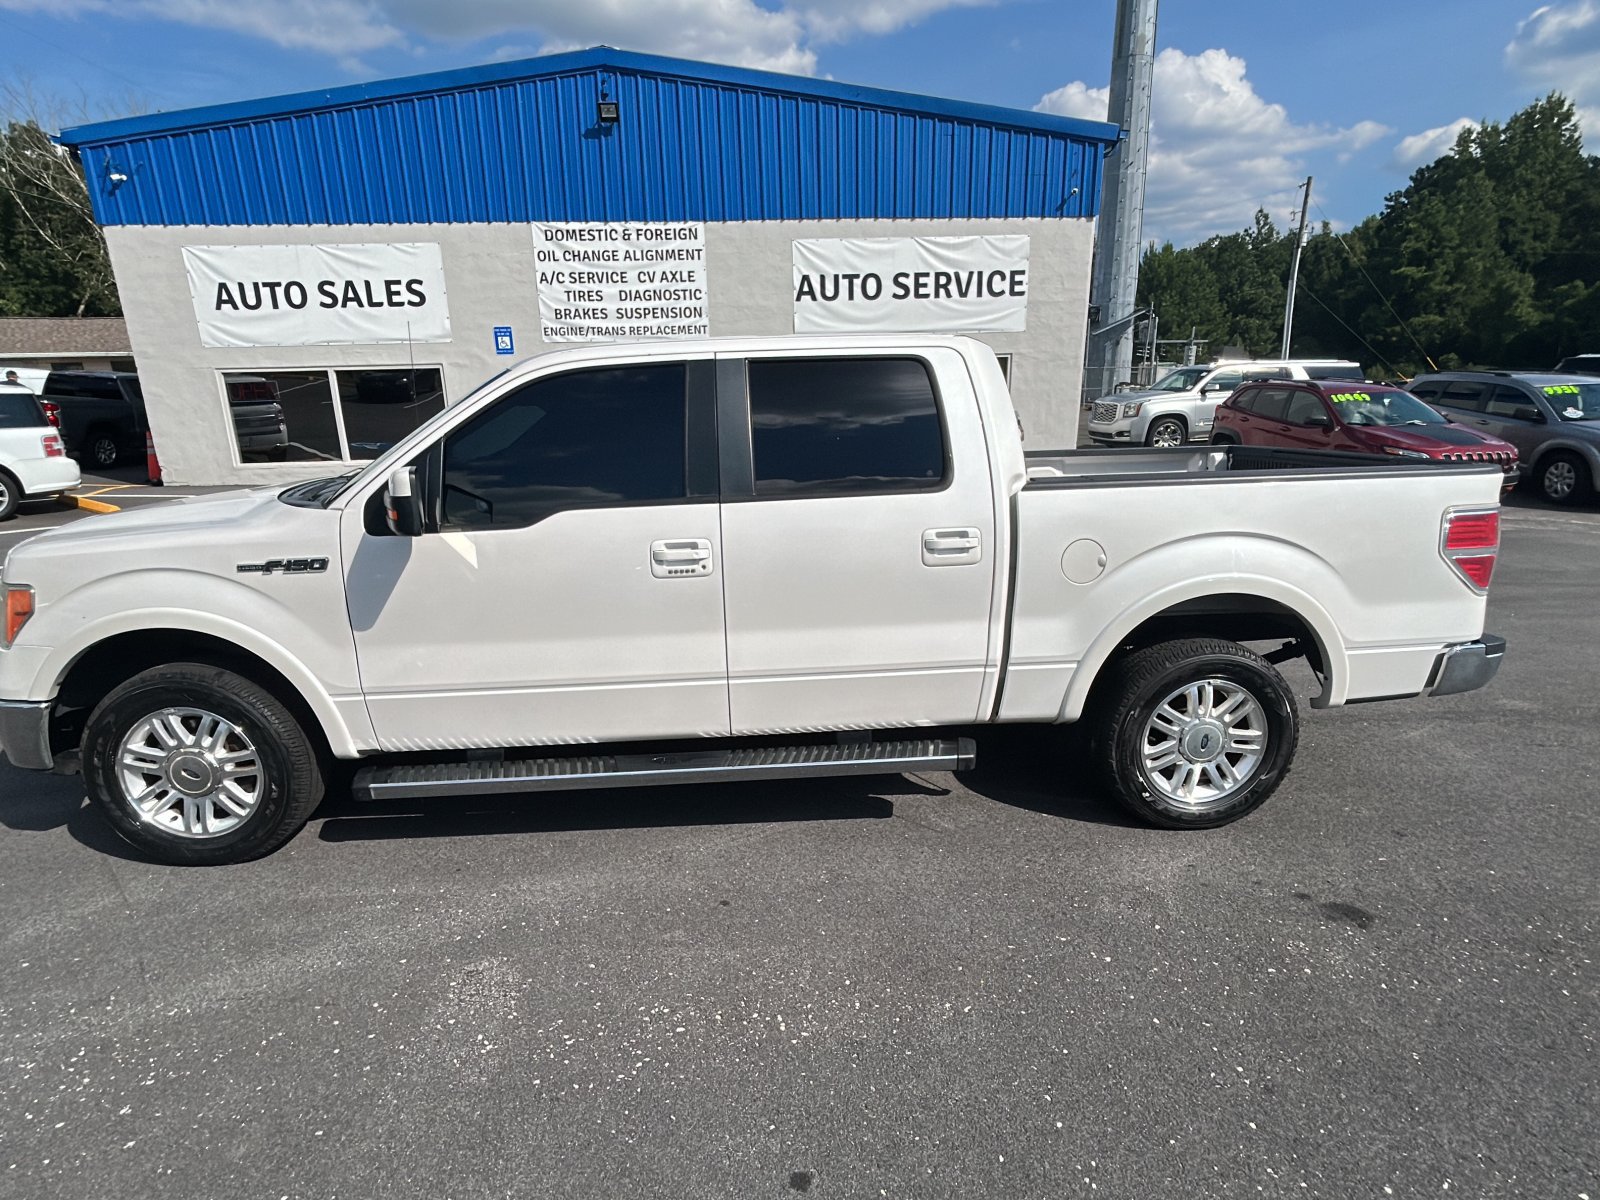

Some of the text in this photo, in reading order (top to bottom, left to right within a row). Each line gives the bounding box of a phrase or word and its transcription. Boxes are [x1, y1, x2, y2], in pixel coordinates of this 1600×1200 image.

[544, 228, 698, 241] DOMESTIC & FOREIGN
[537, 249, 703, 262] OIL CHANGE ALIGNMENT
[539, 270, 695, 285] A/C SERVICE CV AXLE
[795, 270, 1026, 302] AUTO SERVICE
[215, 279, 427, 310] AUTO SALES
[564, 289, 702, 302] TIRES DIAGNOSTIC
[554, 306, 702, 320] BRAKES SUSPENSION
[543, 325, 708, 337] ENGINE/TRANS REPLACEMENT
